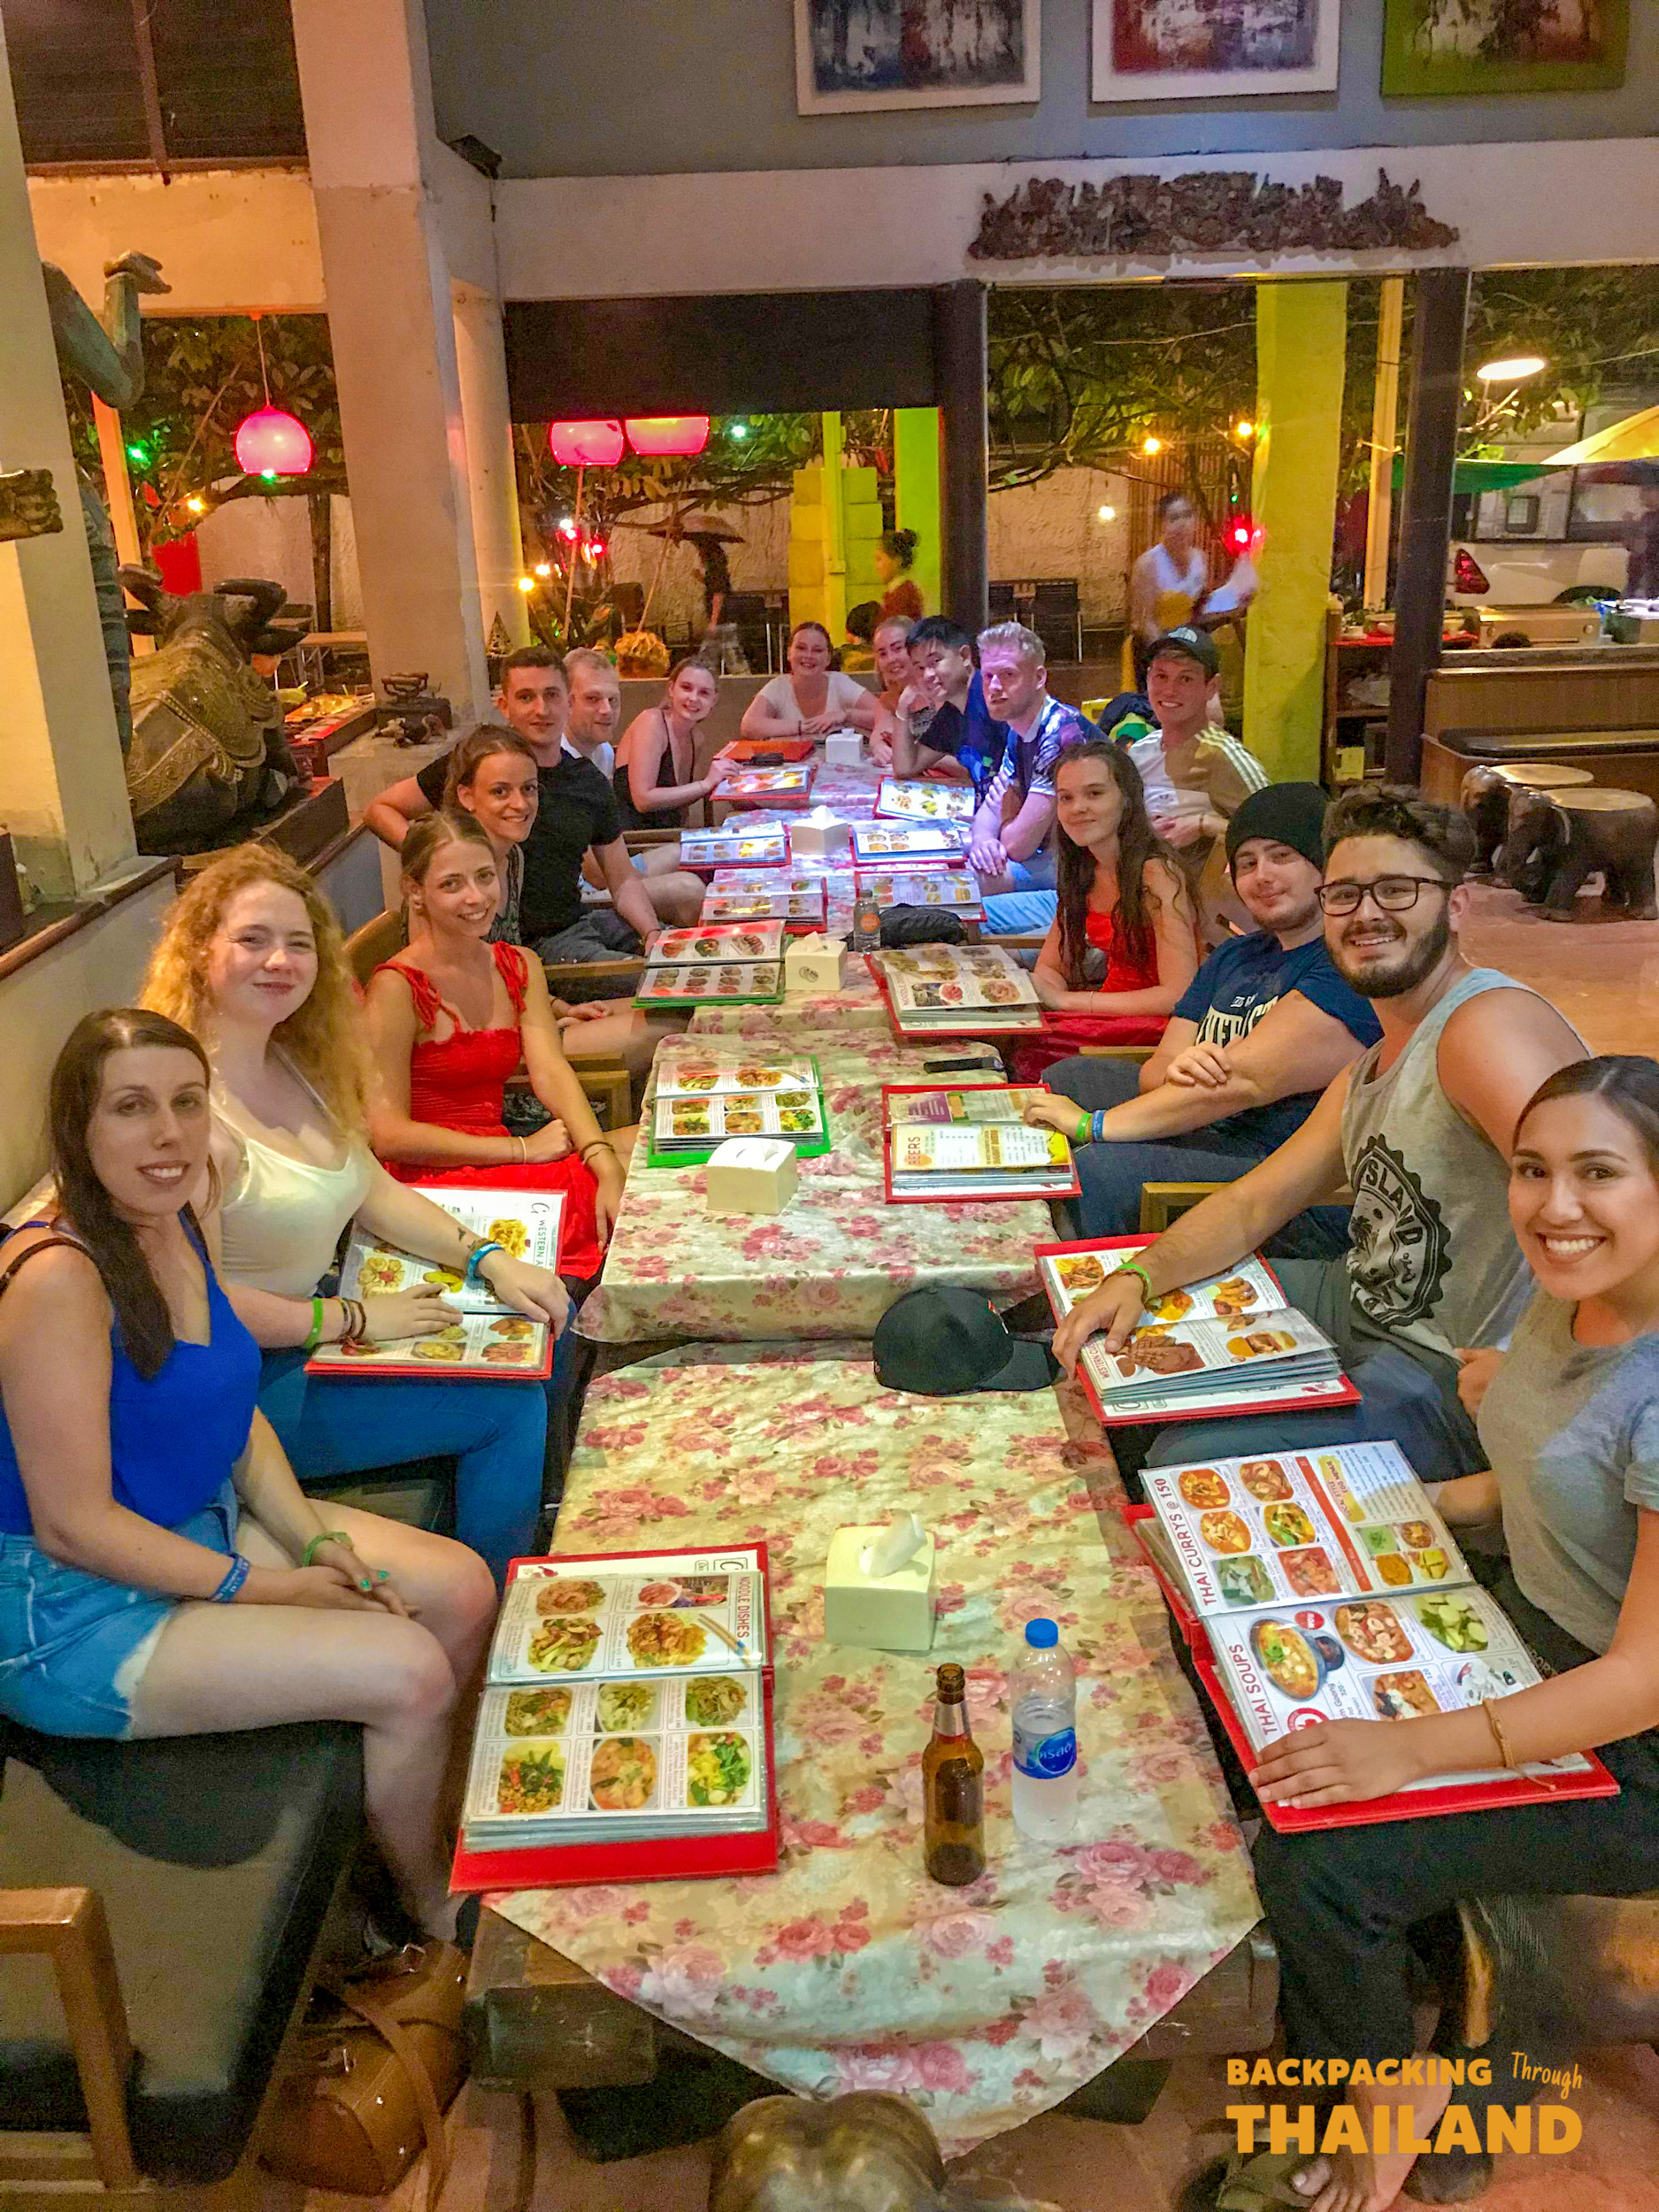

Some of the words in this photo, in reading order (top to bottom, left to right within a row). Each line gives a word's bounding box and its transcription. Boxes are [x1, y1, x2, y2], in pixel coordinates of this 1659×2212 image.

[905, 1135, 923, 1164] BEERS
[1366, 1160, 1424, 1246] SLAND
[534, 1219, 548, 1257] WESTERN
[1090, 1354, 1111, 1379] WESTERN
[1325, 1460, 1341, 1480] MENUS
[1152, 1477, 1174, 1499] 150
[1335, 1479, 1349, 1494] EGG
[1164, 1500, 1179, 1510] @
[1165, 1512, 1205, 1568] CURRYS
[737, 1575, 751, 1603] NOODLE
[1190, 1571, 1220, 1606] THAI
[735, 1604, 750, 1639] DISHES
[1225, 1642, 1264, 1694] SOUPS
[1421, 1667, 1434, 1679] 120
[1249, 1697, 1281, 1735] THAI
